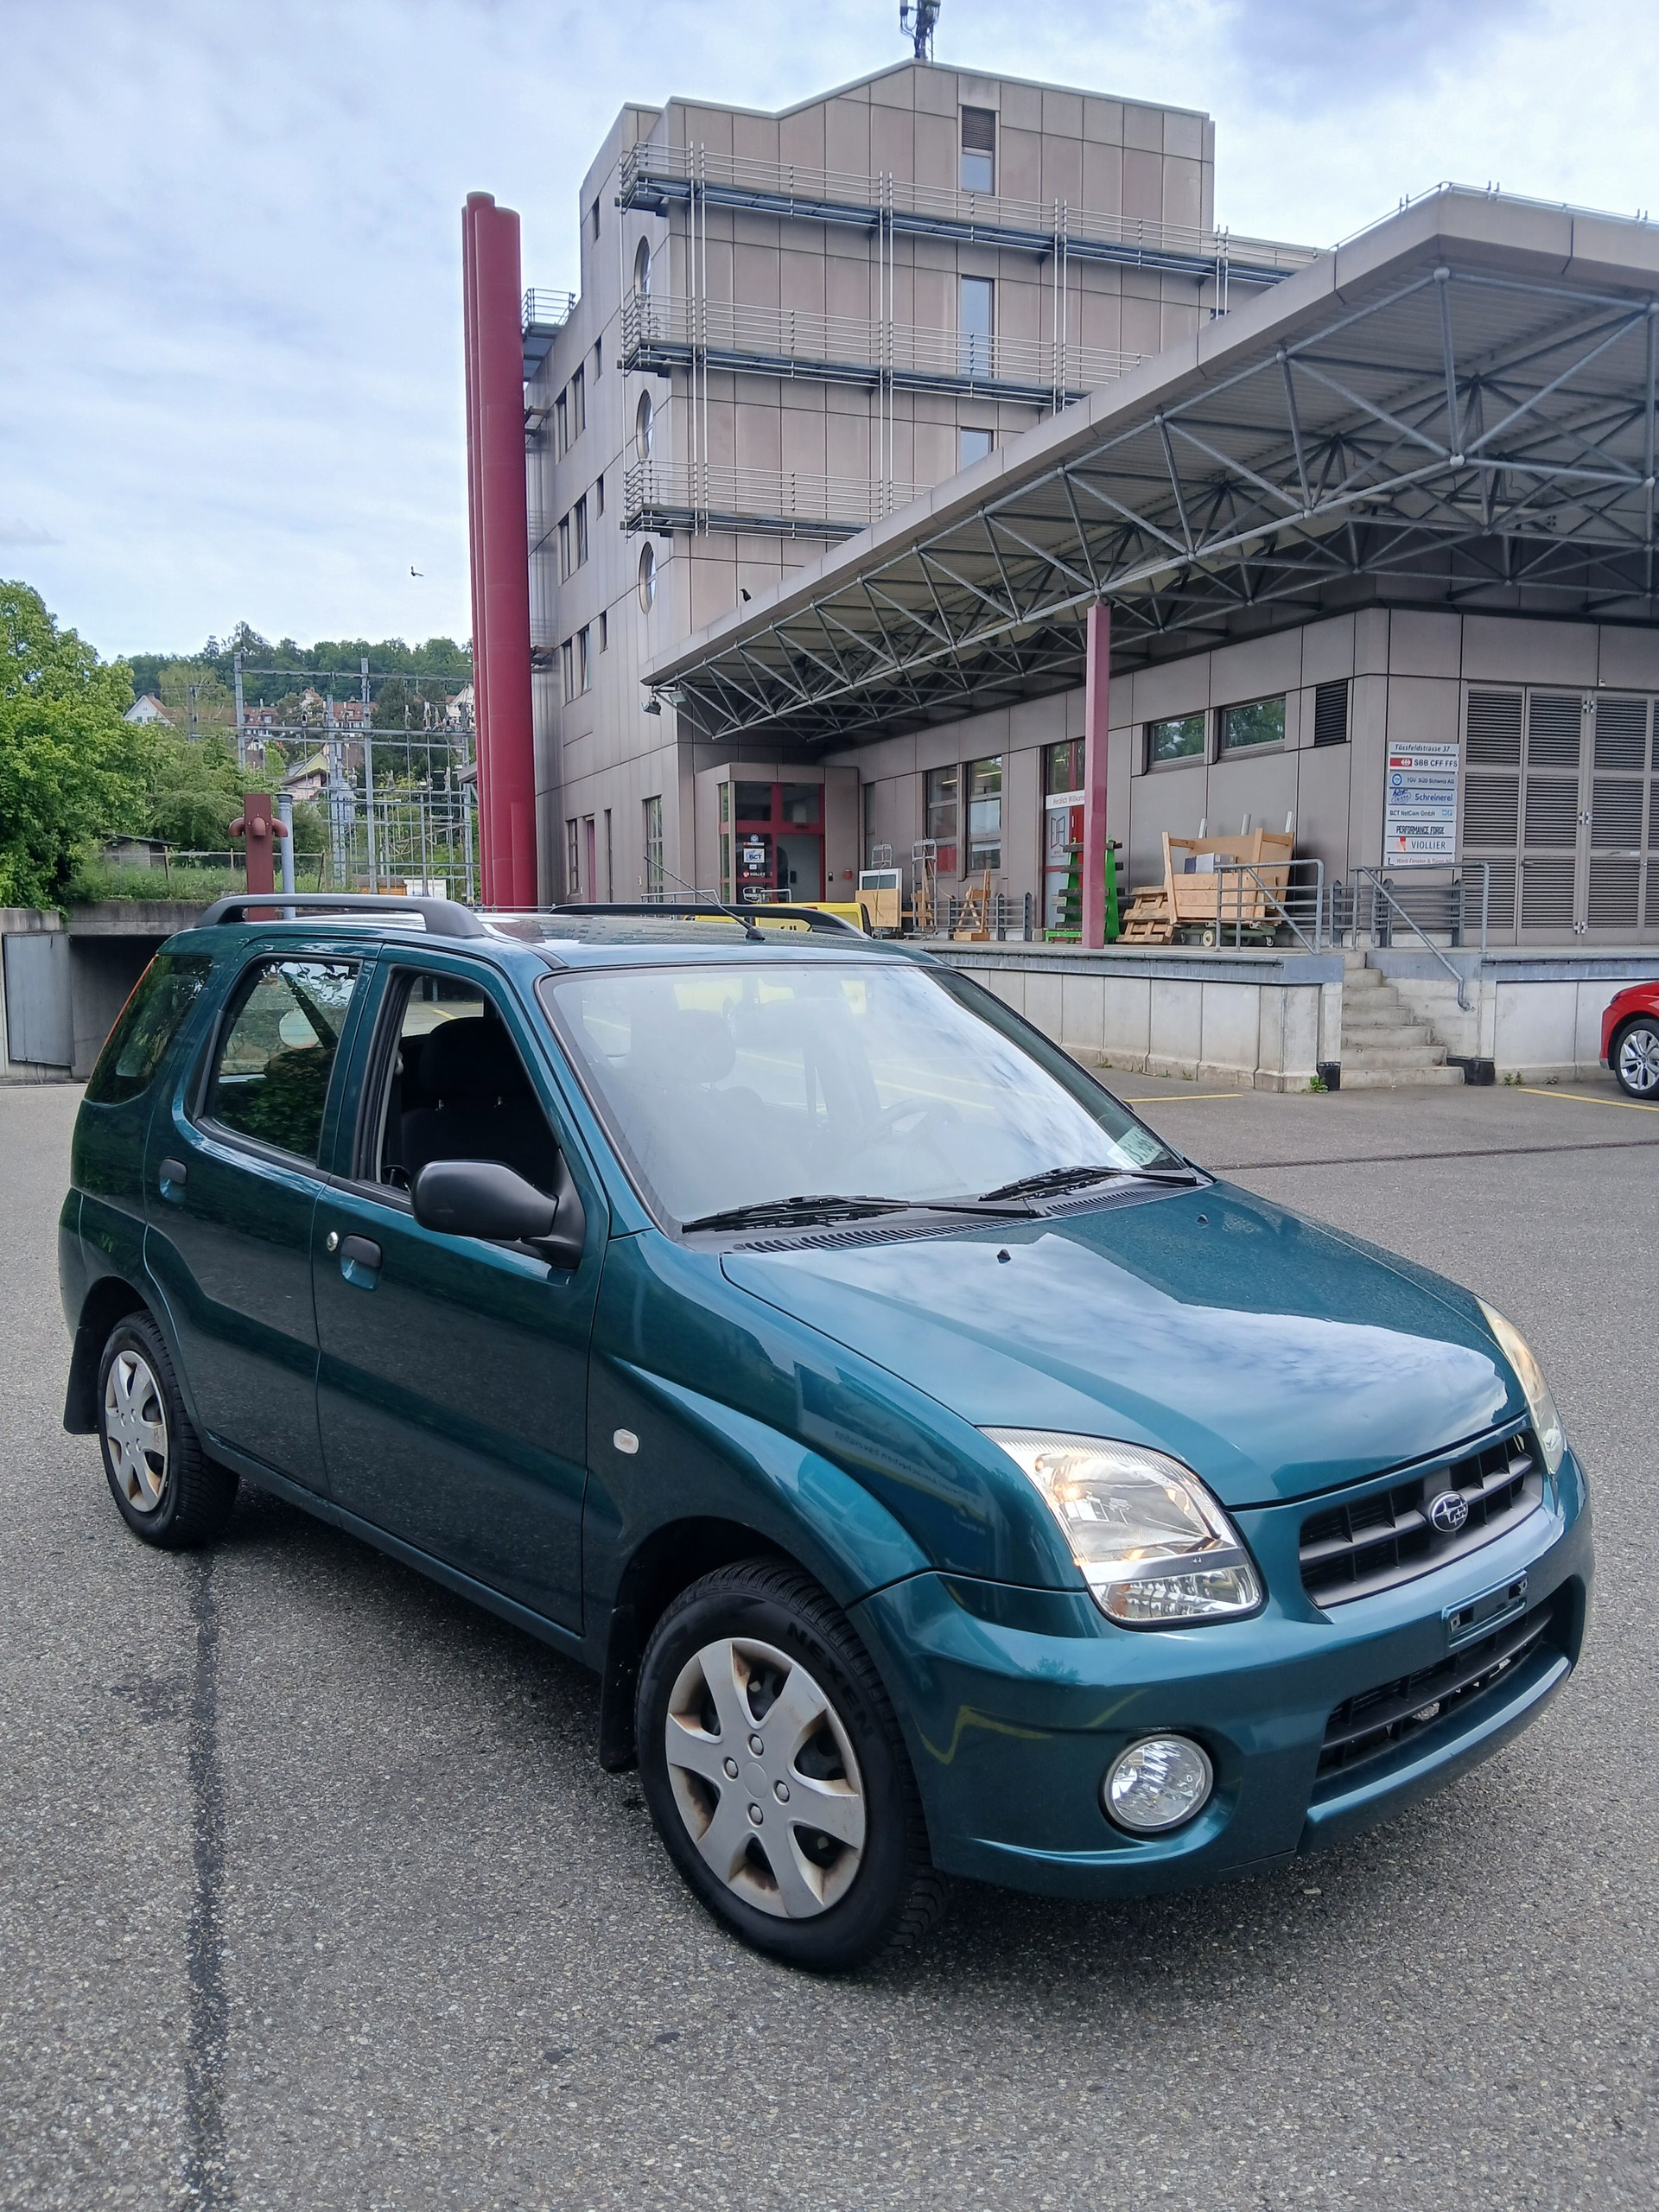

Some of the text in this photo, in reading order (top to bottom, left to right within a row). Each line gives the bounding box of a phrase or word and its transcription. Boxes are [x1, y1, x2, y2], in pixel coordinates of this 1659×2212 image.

[1414, 793, 1453, 802] Schreinerei
[1395, 825, 1445, 835] PERFORMANCE FORGE
[1411, 841, 1446, 849] VIOLLIER
[786, 1621, 874, 1738] NEXEN
